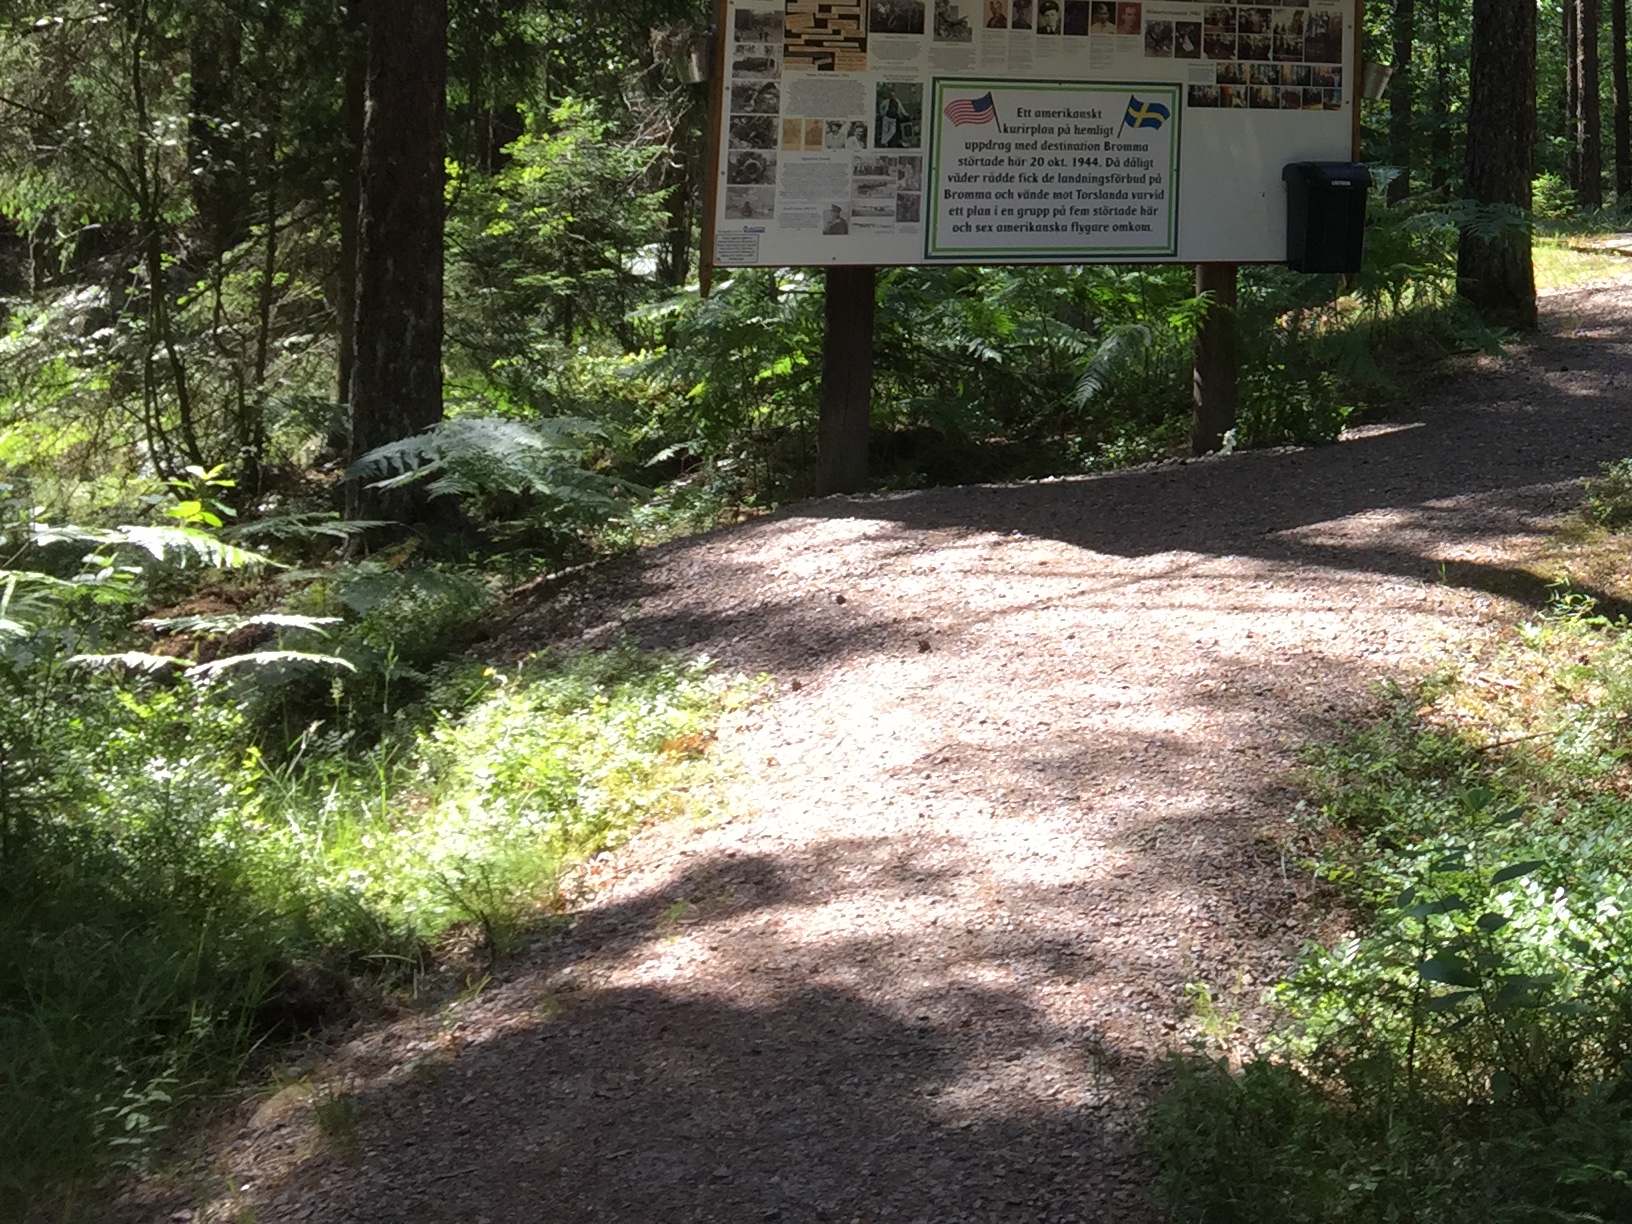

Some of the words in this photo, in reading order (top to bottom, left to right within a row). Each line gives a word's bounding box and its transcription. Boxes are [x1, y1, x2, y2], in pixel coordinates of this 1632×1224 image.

[1016, 106, 1032, 119] Ett
[1034, 106, 1103, 120] amerikanskt
[1003, 124, 1055, 138] kurirplan
[1057, 123, 1071, 137] på
[1073, 124, 1115, 138] hemligt
[964, 140, 1012, 153] uppdrag
[1014, 141, 1038, 151] med
[1040, 140, 1101, 152] destination
[1103, 141, 1149, 152] Bromma
[957, 156, 1005, 167] störtade
[1007, 157, 1028, 167] här
[1030, 157, 1045, 167] 20
[1047, 157, 1068, 168] okt.
[1071, 157, 1103, 168] 1944.
[1105, 157, 1121, 168] Då
[1122, 157, 1155, 169] dåligt
[947, 173, 980, 184] väder
[1018, 172, 1039, 184] fick
[1041, 173, 1055, 184] de
[1057, 173, 1147, 188] landningsförbud
[1148, 173, 1162, 187] på
[944, 189, 992, 200] Bromma
[994, 189, 1015, 200] och
[1017, 189, 1050, 200] vände
[1052, 190, 1074, 201] mot
[1075, 189, 1129, 201] Torslanda
[1131, 190, 1165, 201] varvid
[948, 206, 964, 217] ett
[966, 206, 991, 219] plan
[1000, 207, 1015, 217] en
[1017, 207, 1050, 220] grupp
[1052, 206, 1067, 219] på
[1069, 206, 1091, 217] fem
[1092, 206, 1138, 217] störtade
[1139, 206, 1160, 217] här
[952, 222, 972, 233] och
[975, 223, 994, 233] sex
[996, 222, 1068, 234] amerikanska
[1070, 222, 1110, 235] flygare
[1112, 222, 1154, 234] omkom.
